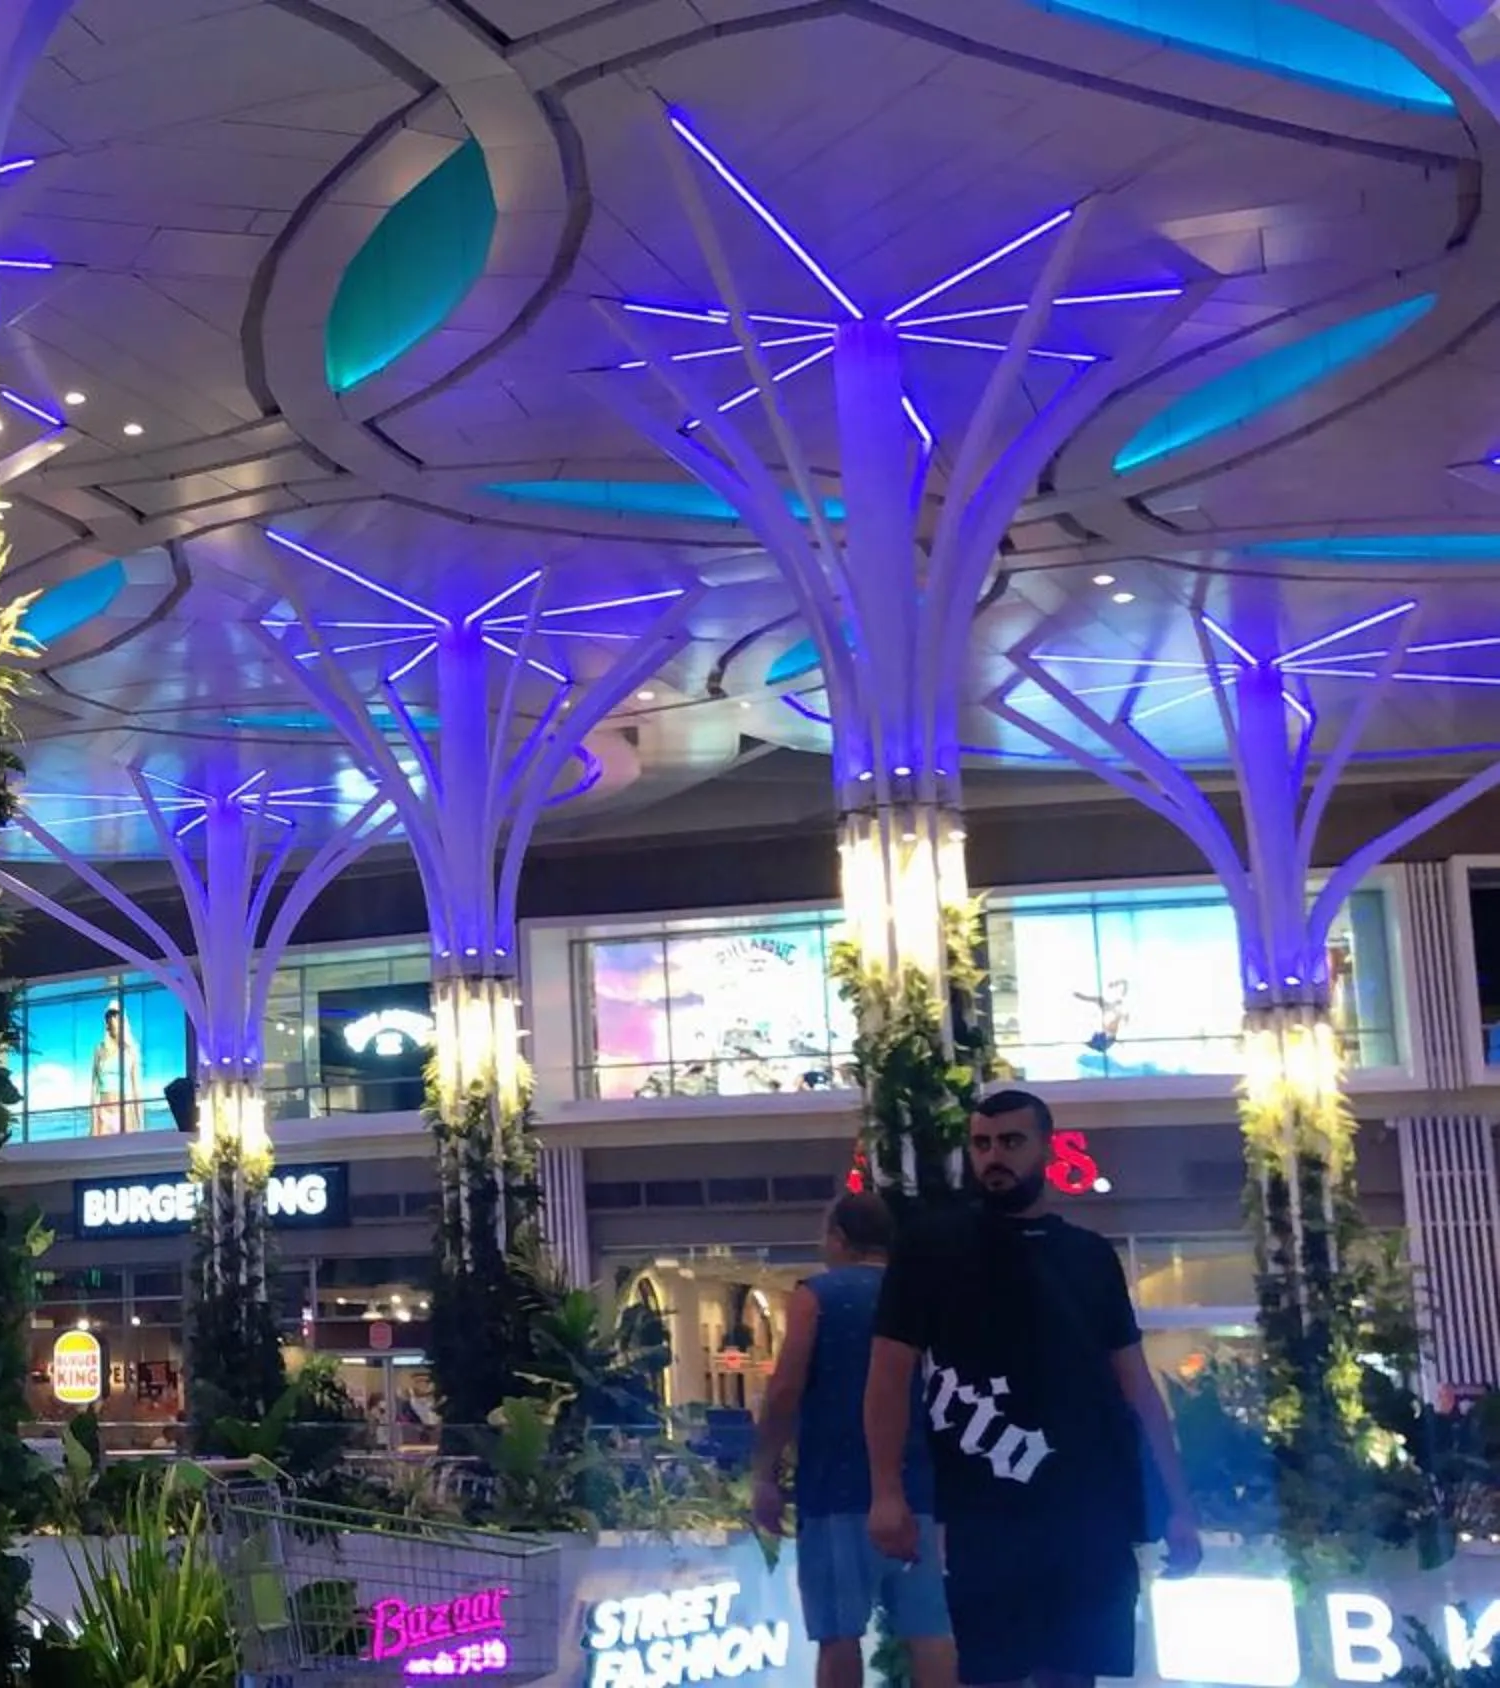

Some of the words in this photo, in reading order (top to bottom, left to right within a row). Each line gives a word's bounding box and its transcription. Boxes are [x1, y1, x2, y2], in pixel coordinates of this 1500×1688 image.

[266, 1174, 327, 1215] NG
[56, 1368, 99, 1386] KING
[590, 1581, 741, 1649] STREET
[591, 1620, 789, 1688] FASHION
